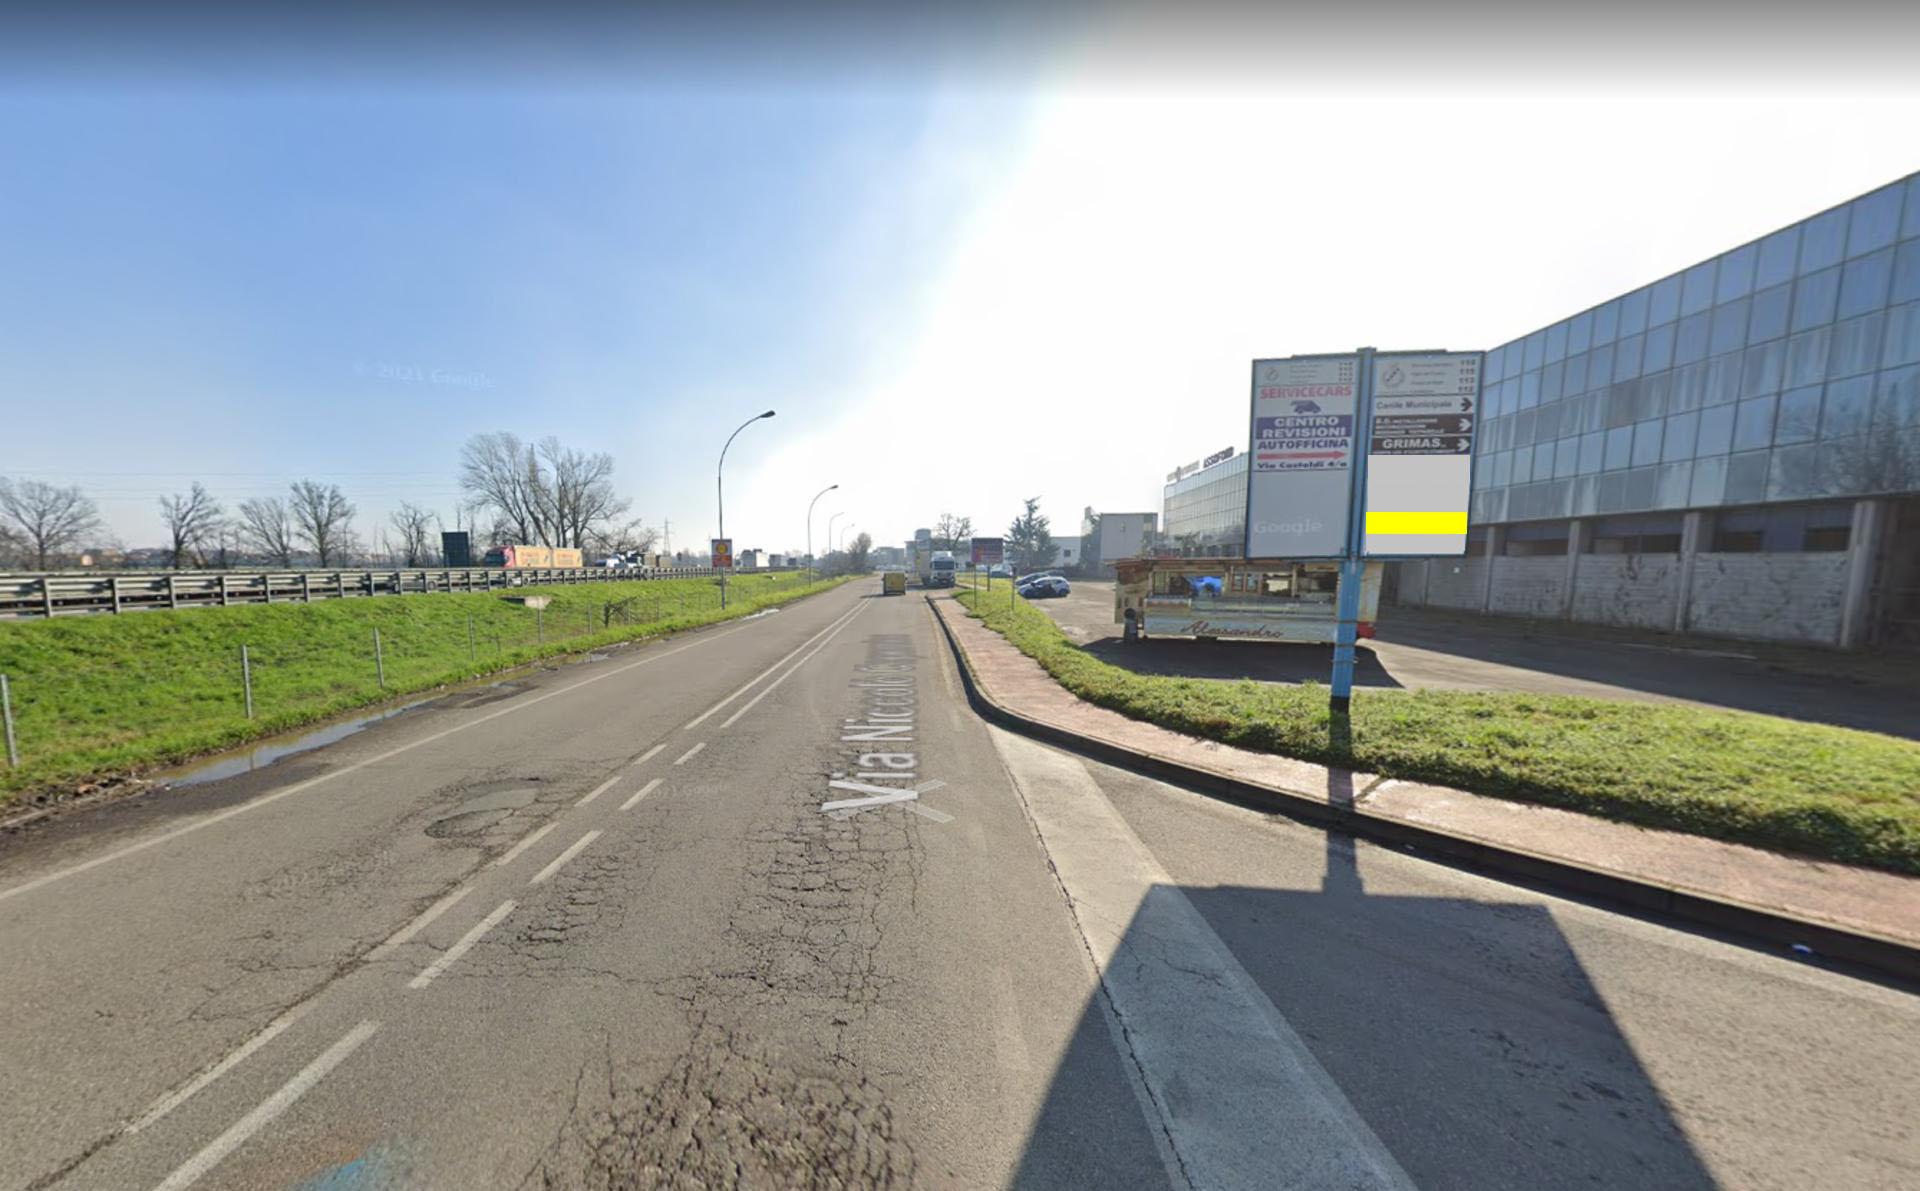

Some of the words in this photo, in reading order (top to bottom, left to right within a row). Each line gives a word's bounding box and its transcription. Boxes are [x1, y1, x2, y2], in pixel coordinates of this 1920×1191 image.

[1260, 385, 1352, 400] SERVICECARS
[1274, 416, 1339, 427] CENTRO
[1262, 426, 1346, 438] REVISIONI
[1258, 438, 1349, 450] AUTOFFICINA
[1382, 438, 1440, 449] GRIMAS
[1257, 462, 1276, 470] Via
